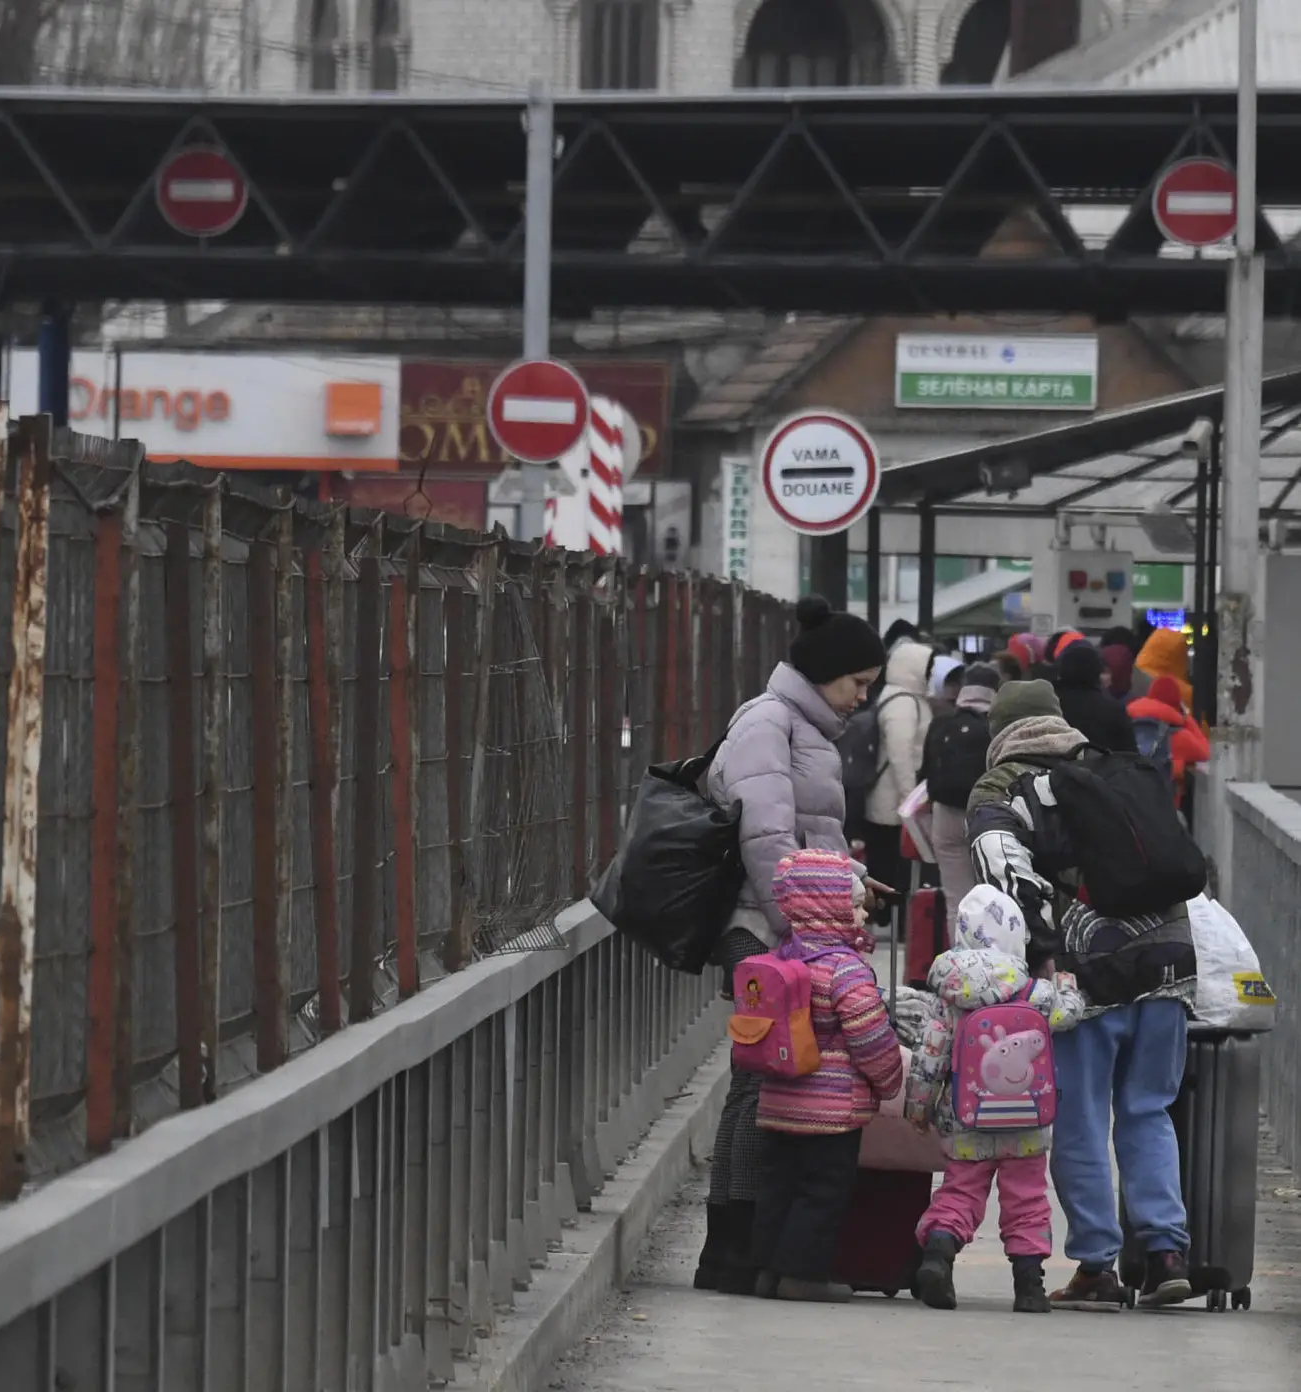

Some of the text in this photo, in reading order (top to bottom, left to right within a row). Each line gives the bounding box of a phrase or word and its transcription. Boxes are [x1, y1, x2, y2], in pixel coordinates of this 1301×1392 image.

[1012, 376, 1075, 398] КАРТА
[69, 377, 230, 431] Orange
[792, 448, 841, 462] VAMA
[782, 482, 855, 497] DOUANE
